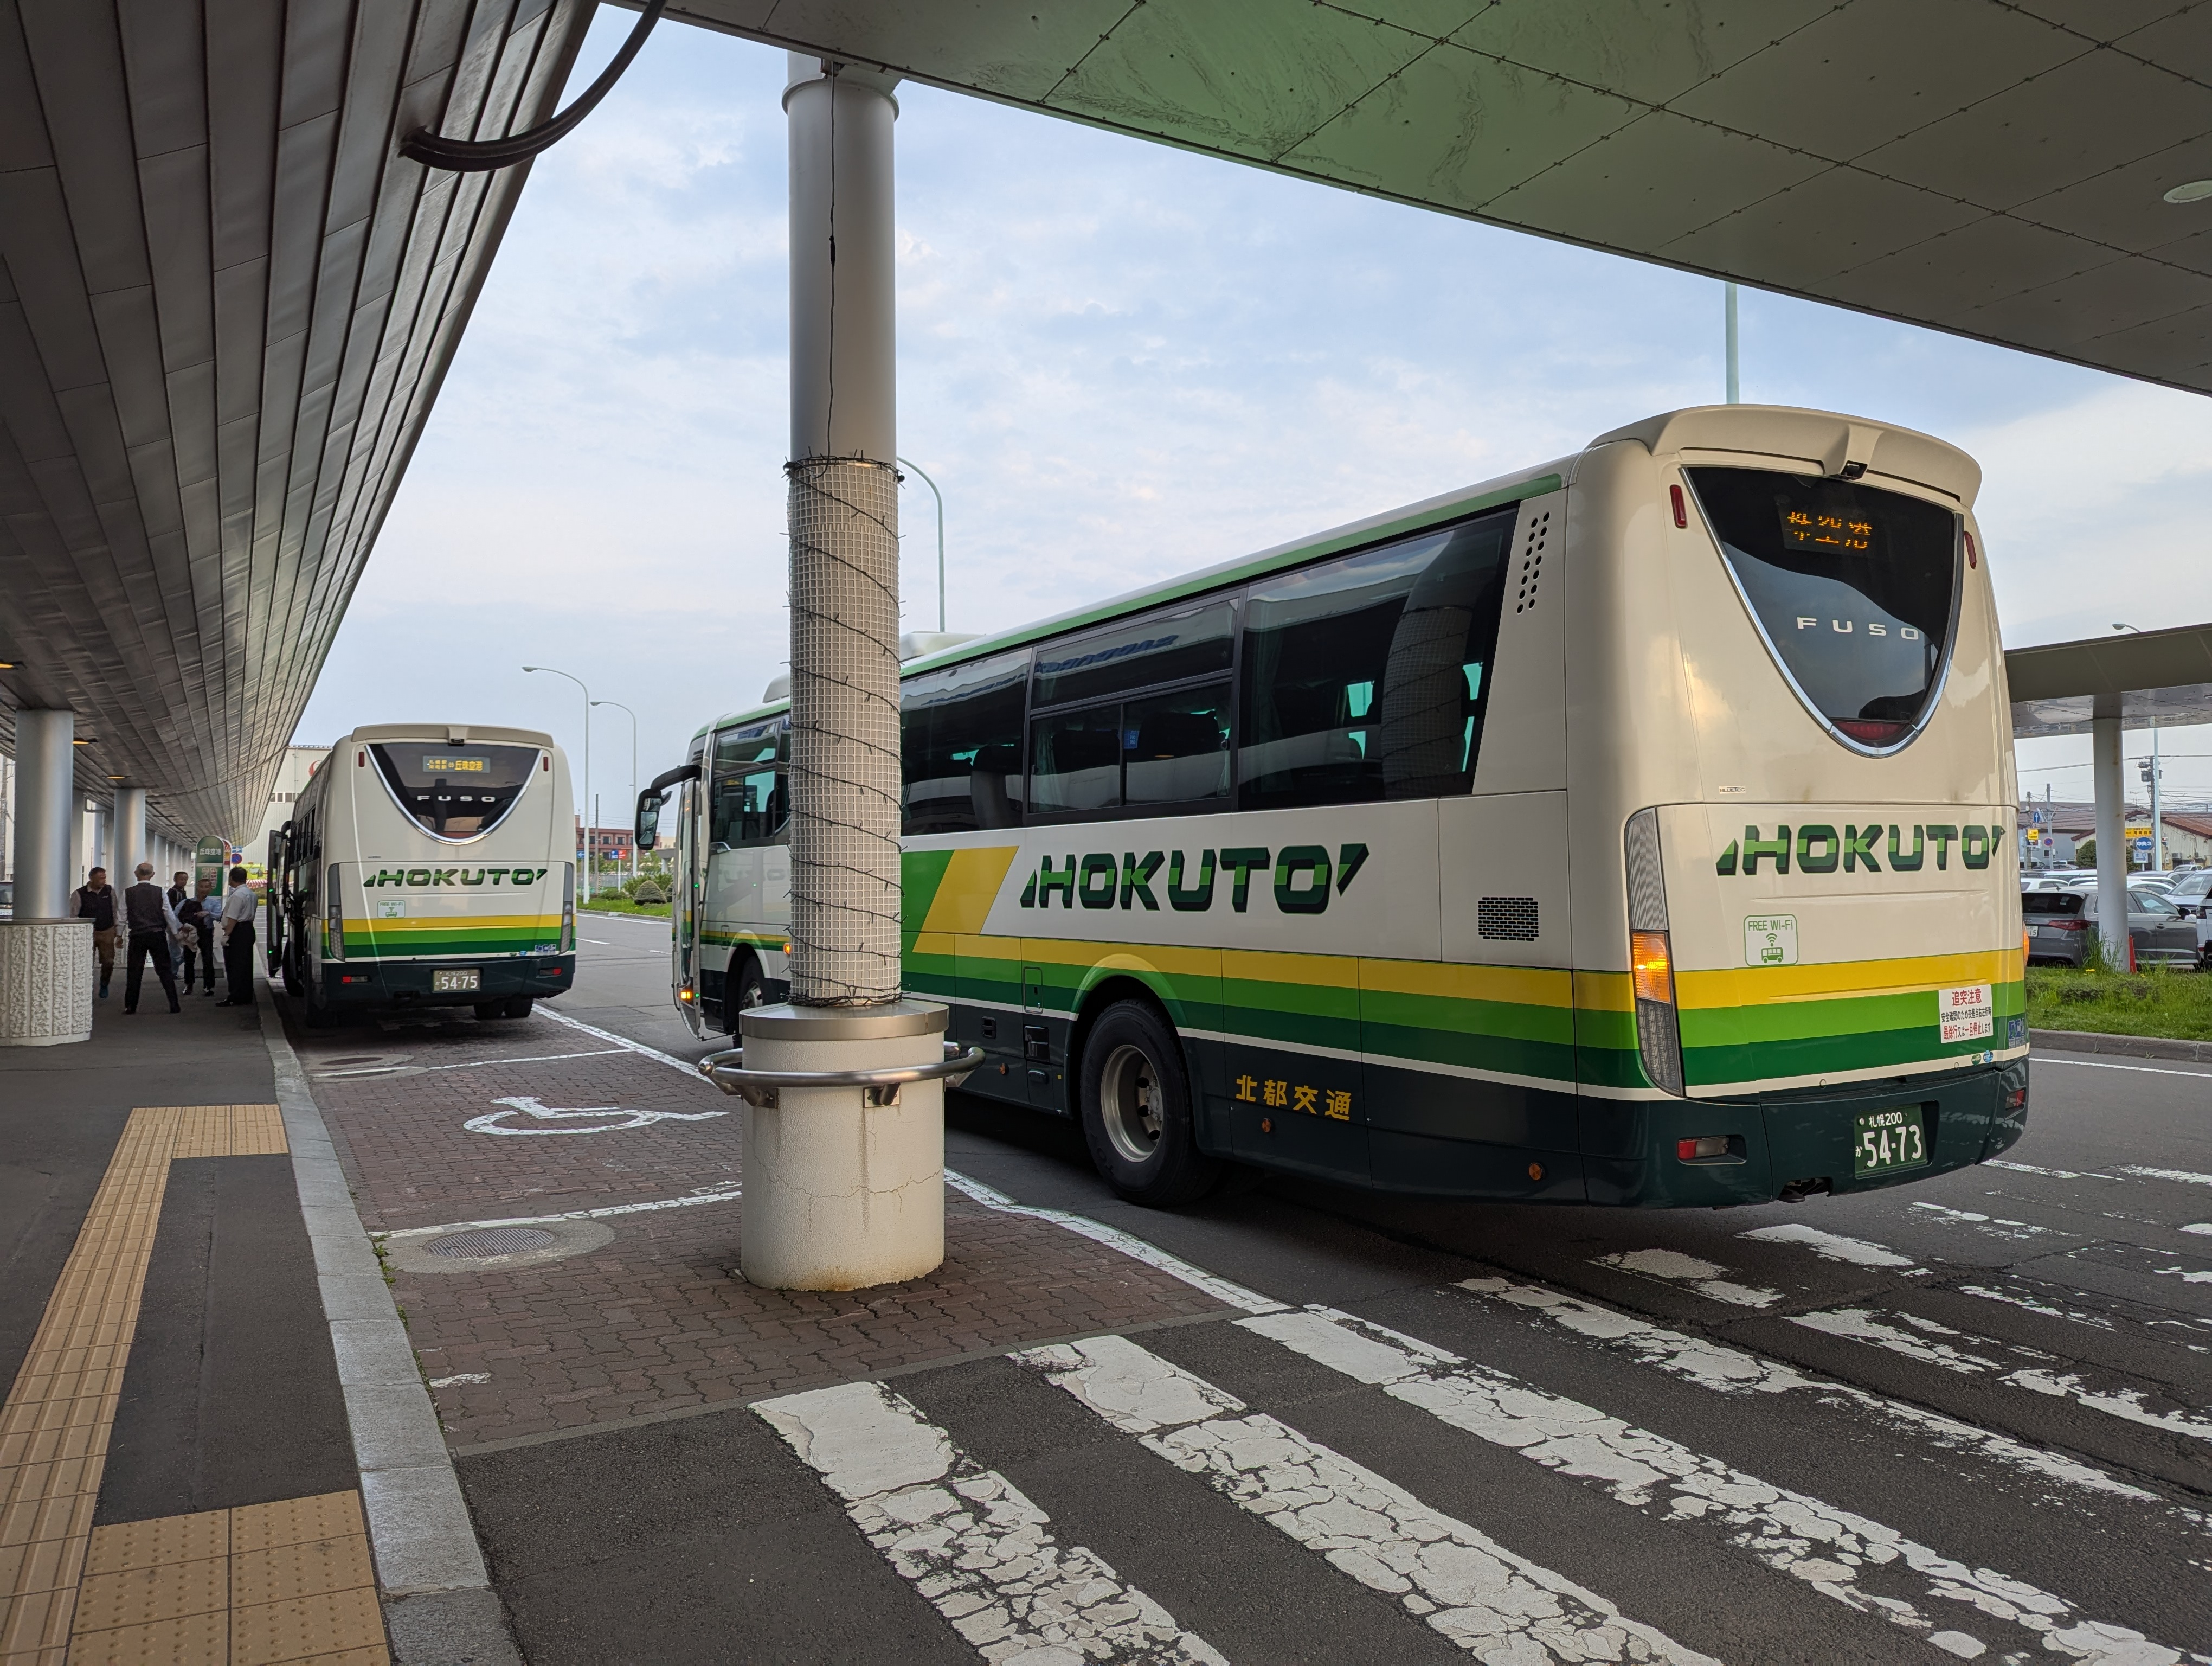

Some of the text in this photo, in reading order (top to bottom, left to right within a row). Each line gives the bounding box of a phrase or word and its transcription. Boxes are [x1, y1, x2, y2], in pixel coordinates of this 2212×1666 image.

[1797, 617, 1919, 640] FUSO
[1742, 824, 1990, 875] HOKUTO
[377, 868, 535, 887] HOKUTO
[1038, 844, 1333, 915] HOKUTO
[1748, 919, 1793, 931] FREE Wi-Fi
[441, 976, 478, 990] 54-75
[1952, 988, 1982, 1007] 追突注意
[1236, 1074, 1352, 1121] 北都交通
[1855, 1125, 1922, 1167] か 54-73
